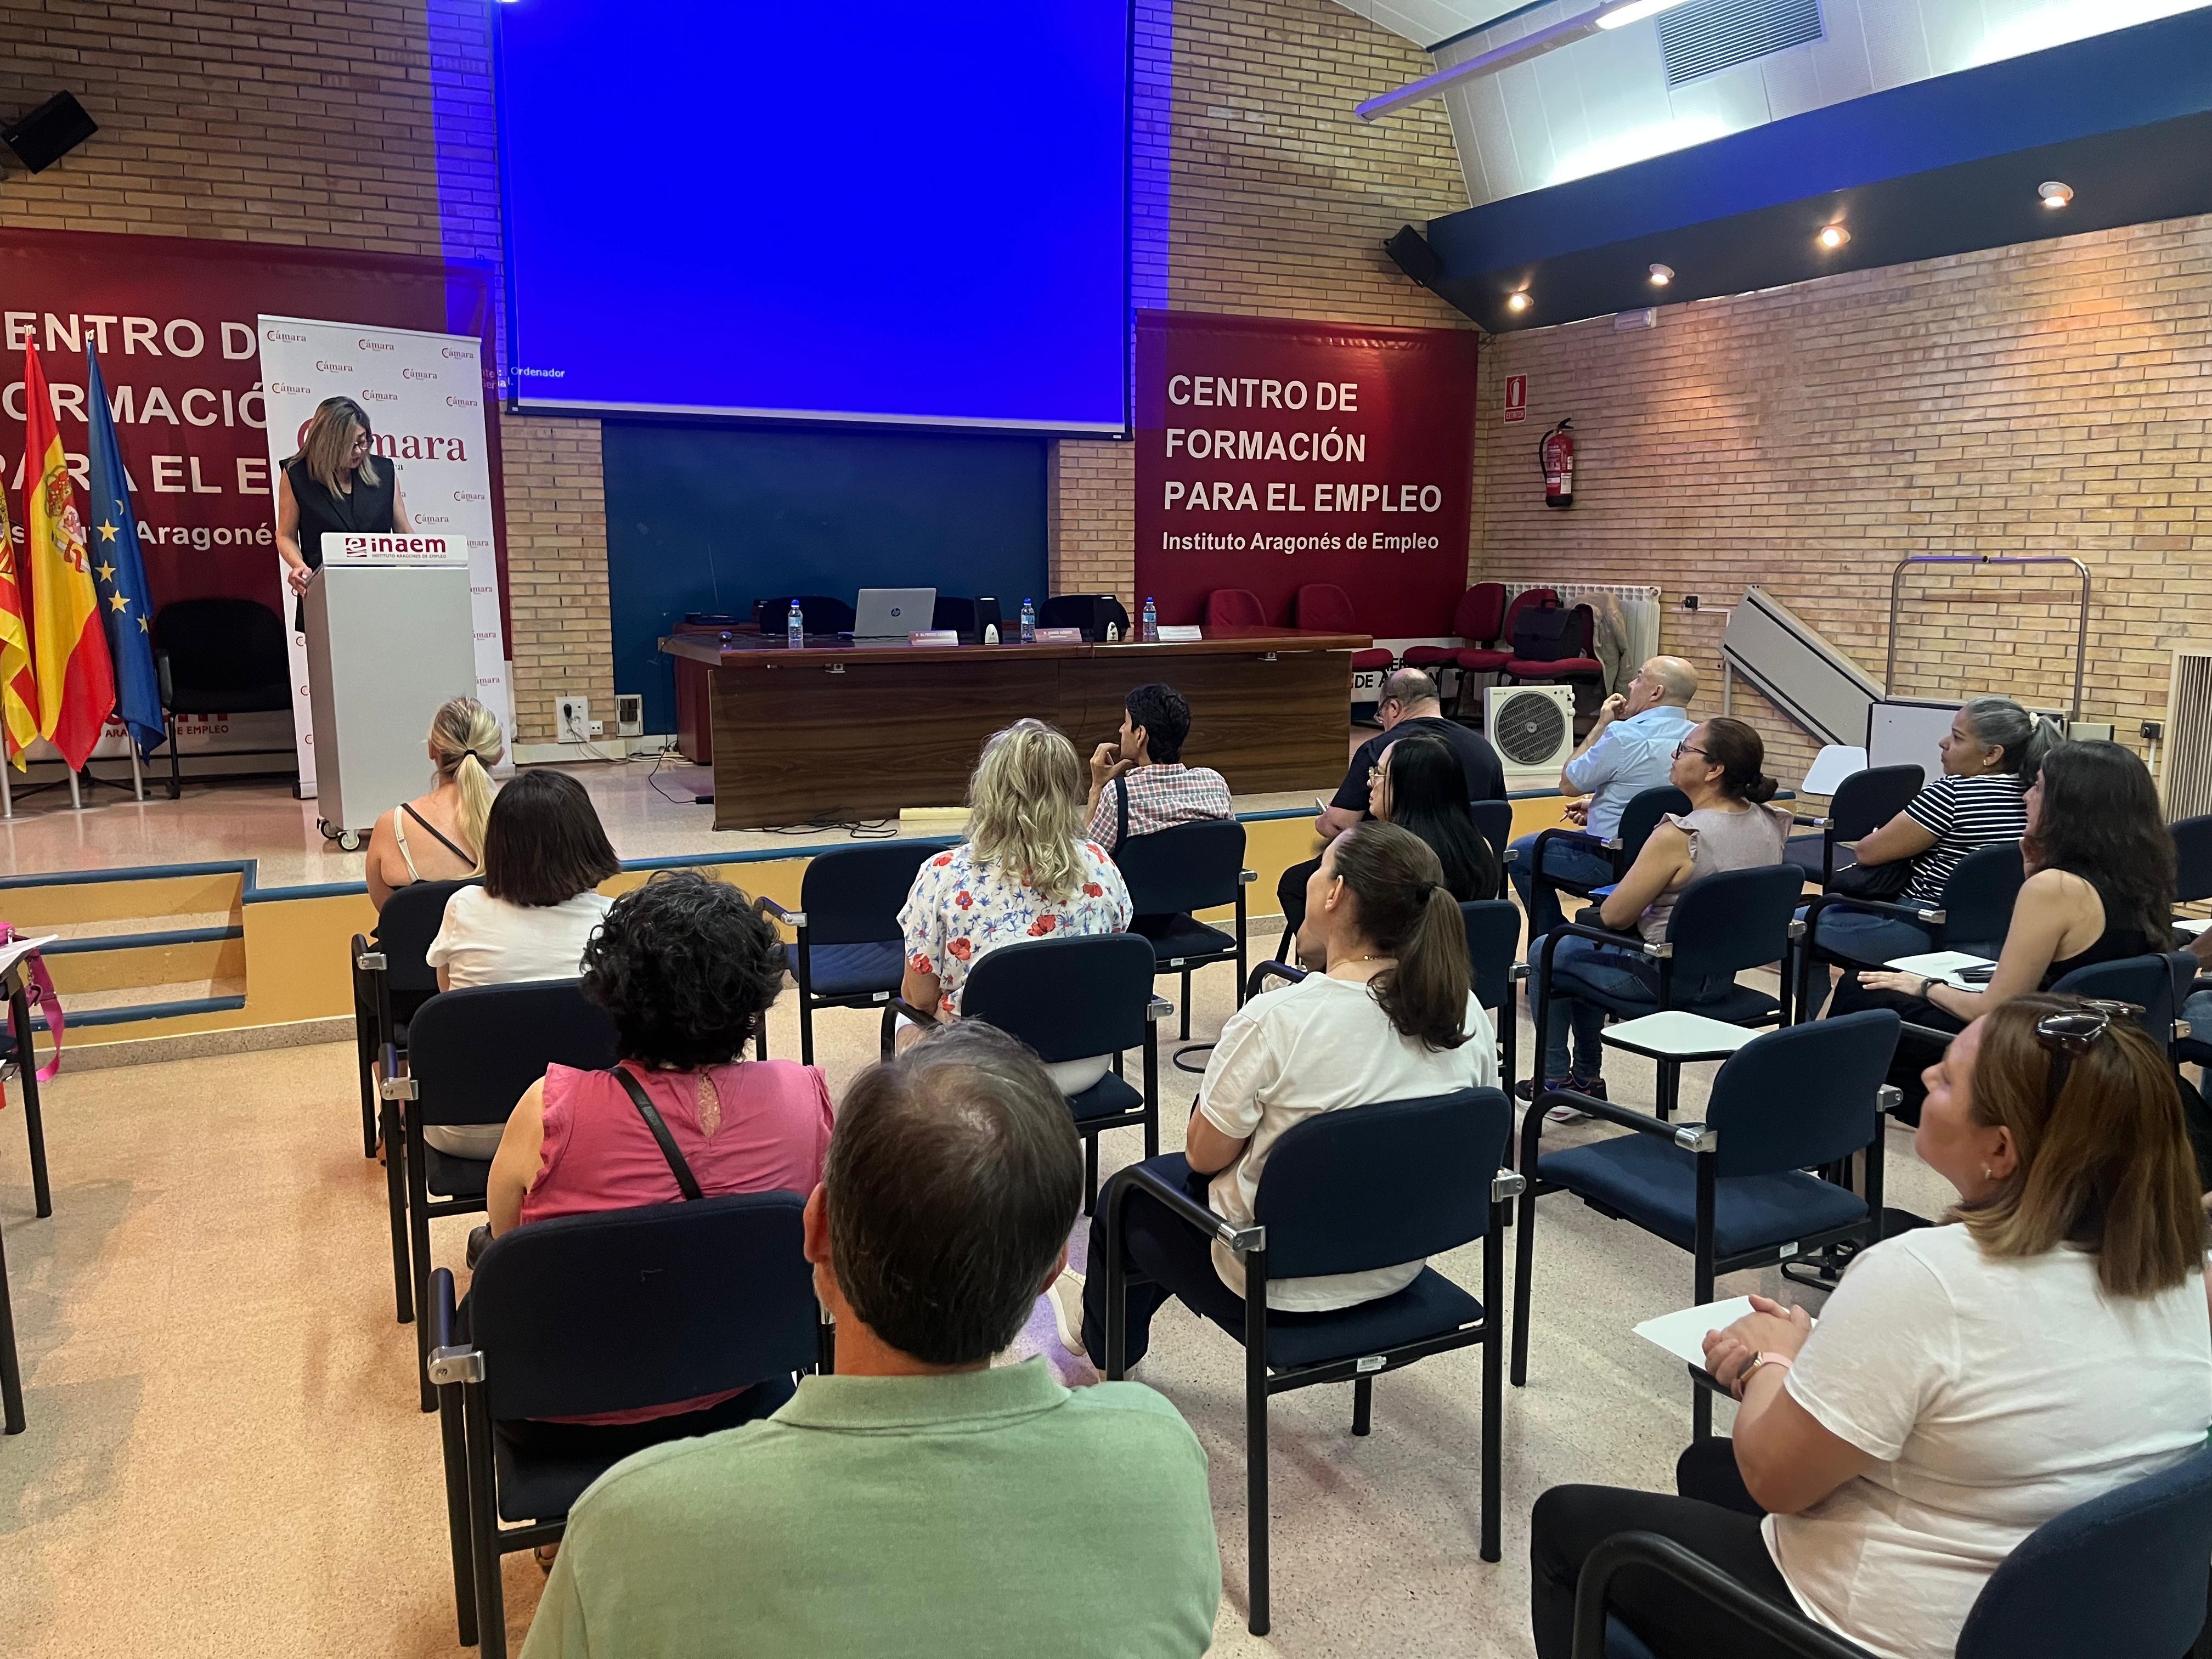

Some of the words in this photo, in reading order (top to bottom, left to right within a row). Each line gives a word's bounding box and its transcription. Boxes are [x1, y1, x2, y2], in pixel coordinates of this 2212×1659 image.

[4, 312, 204, 358] ENTRO
[221, 322, 256, 360] D
[267, 330, 307, 342] Cámara
[358, 338, 394, 351] Cámara
[442, 347, 474, 359] Cámara
[316, 360, 353, 372] Cámara
[511, 366, 565, 377] Ordenador
[403, 368, 437, 380] Cámara
[272, 382, 311, 394] Cámara
[1168, 375, 1307, 410] CENTRO
[1316, 382, 1358, 411] DE
[363, 390, 398, 401] Cámara
[446, 396, 478, 407] Cámara
[2, 382, 267, 428] ORMACIÓ
[297, 418, 467, 461] mara
[1166, 426, 1365, 462] FORMACIÓN
[151, 455, 222, 493] EL
[454, 490, 485, 501] Cámara
[1164, 481, 1259, 511] PARA
[1267, 483, 1306, 511] EL
[1314, 484, 1442, 512] EMPLEO
[415, 513, 449, 524] Cámara
[137, 521, 275, 551] Aragoné
[371, 538, 446, 553] inaem
[1163, 532, 1246, 550] Instituto
[1250, 532, 1341, 554] Aragonés
[1346, 532, 1367, 550] de
[1372, 532, 1439, 554] Empleo
[1355, 674, 1373, 688] DE
[187, 725, 229, 734] EMPLEO
